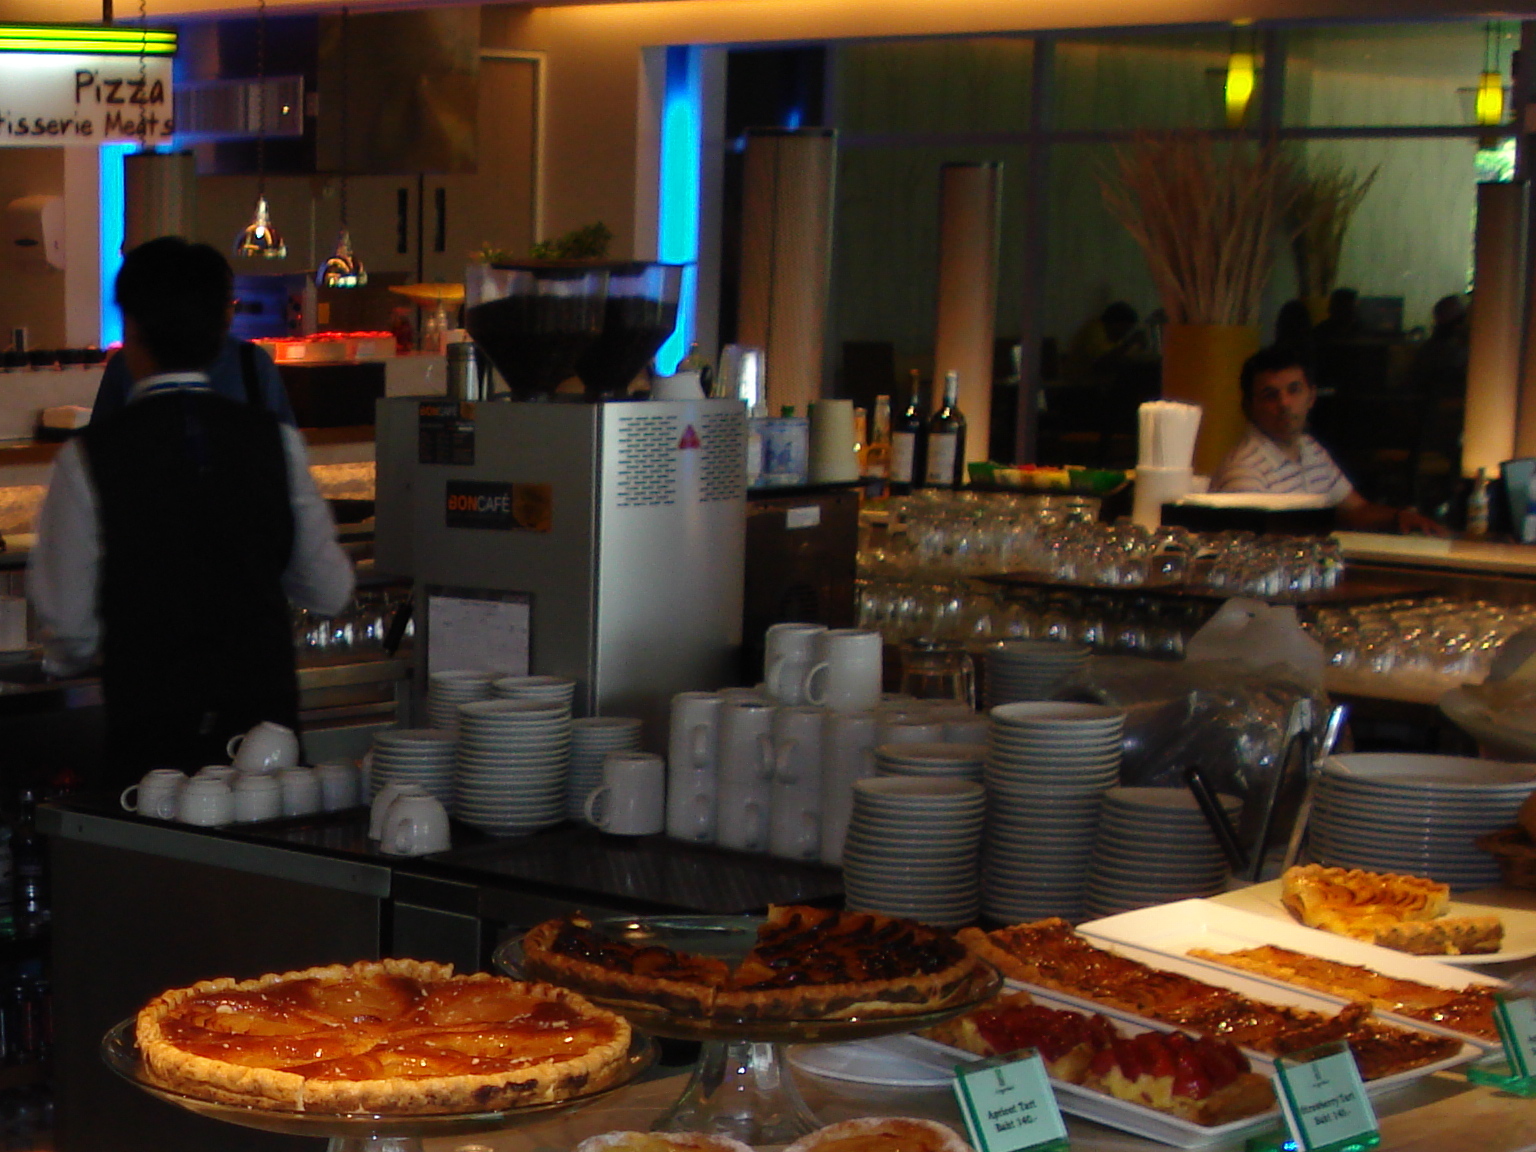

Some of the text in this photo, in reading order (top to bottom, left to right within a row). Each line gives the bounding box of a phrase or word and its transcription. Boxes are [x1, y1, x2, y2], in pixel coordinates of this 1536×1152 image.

[75, 69, 164, 104] Pizza
[105, 110, 175, 137] Meats
[448, 493, 511, 512] BONCAFÉ
[988, 1099, 1037, 1120] Apricot Tart
[995, 1120, 1016, 1133] Baht
